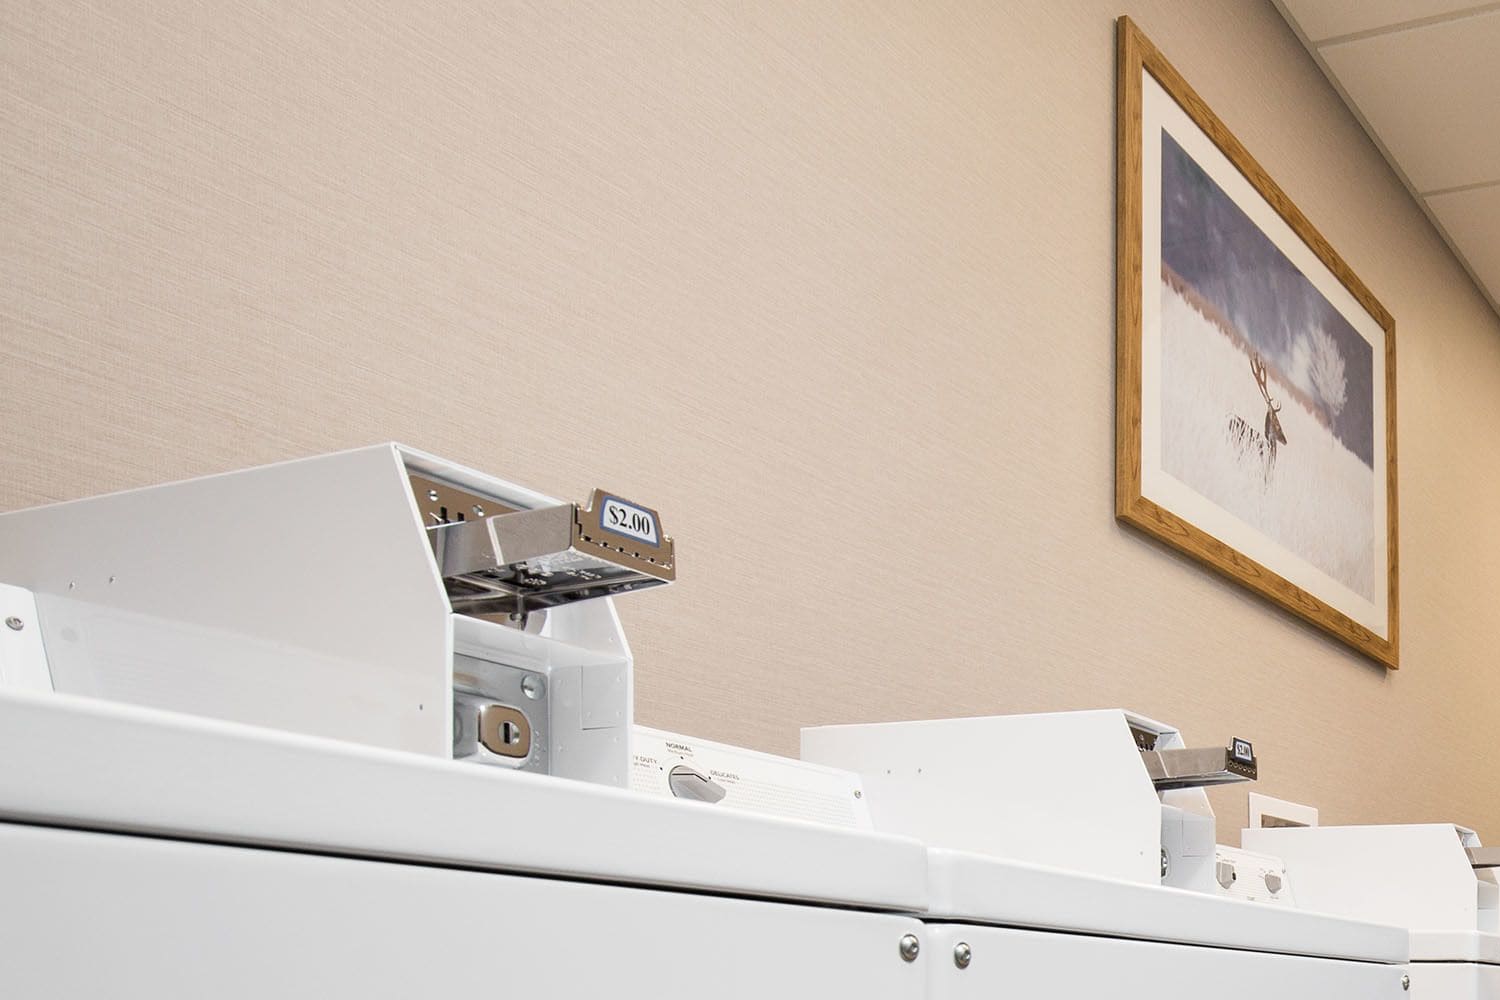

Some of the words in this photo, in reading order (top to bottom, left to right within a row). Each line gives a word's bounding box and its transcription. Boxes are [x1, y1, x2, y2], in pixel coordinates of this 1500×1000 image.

[609, 505, 651, 536] $2.00
[665, 741, 693, 753] NORMAL
[640, 756, 658, 765] DUTY
